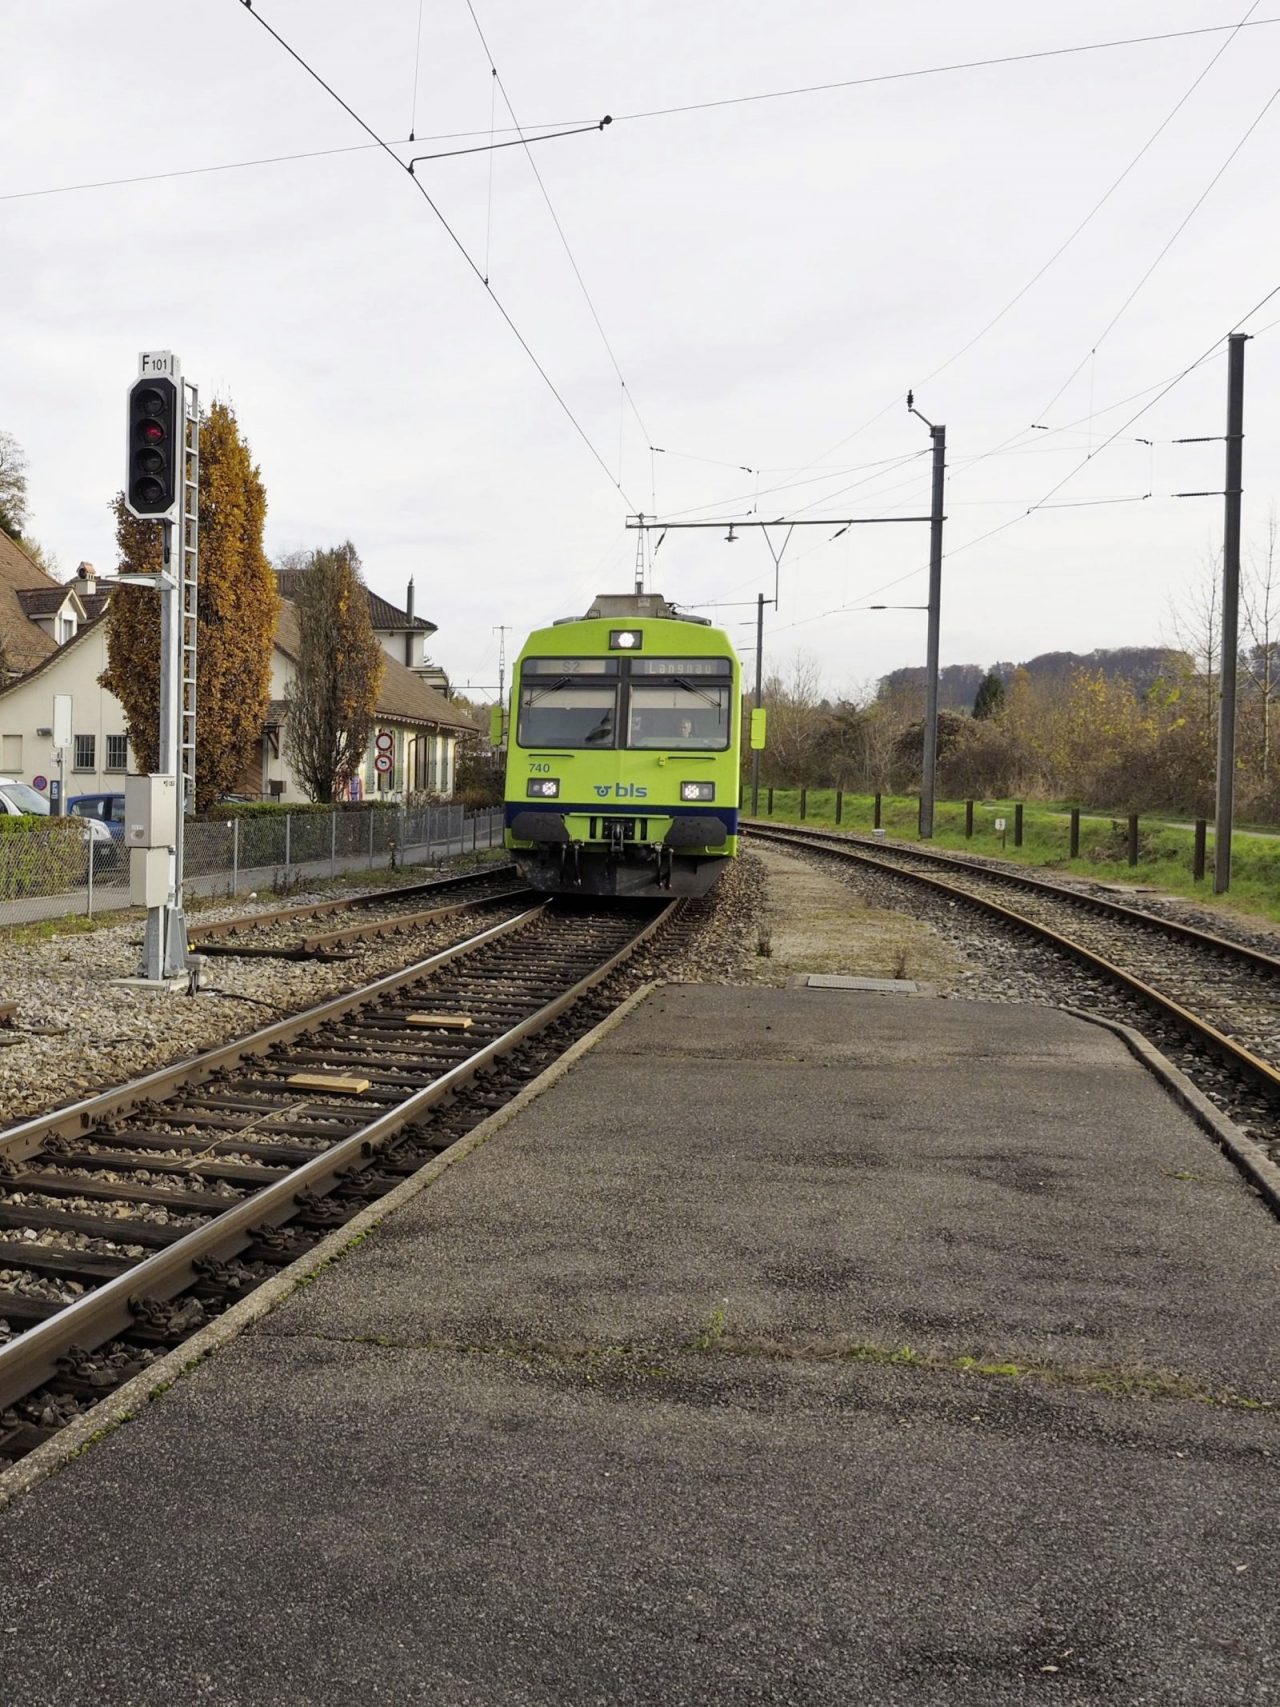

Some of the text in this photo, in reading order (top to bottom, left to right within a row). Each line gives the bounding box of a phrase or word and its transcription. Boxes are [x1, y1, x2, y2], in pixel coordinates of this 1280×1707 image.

[562, 661, 581, 673] S2
[649, 661, 712, 674] Langnau
[529, 763, 550, 773] 740
[615, 783, 648, 798] bls
